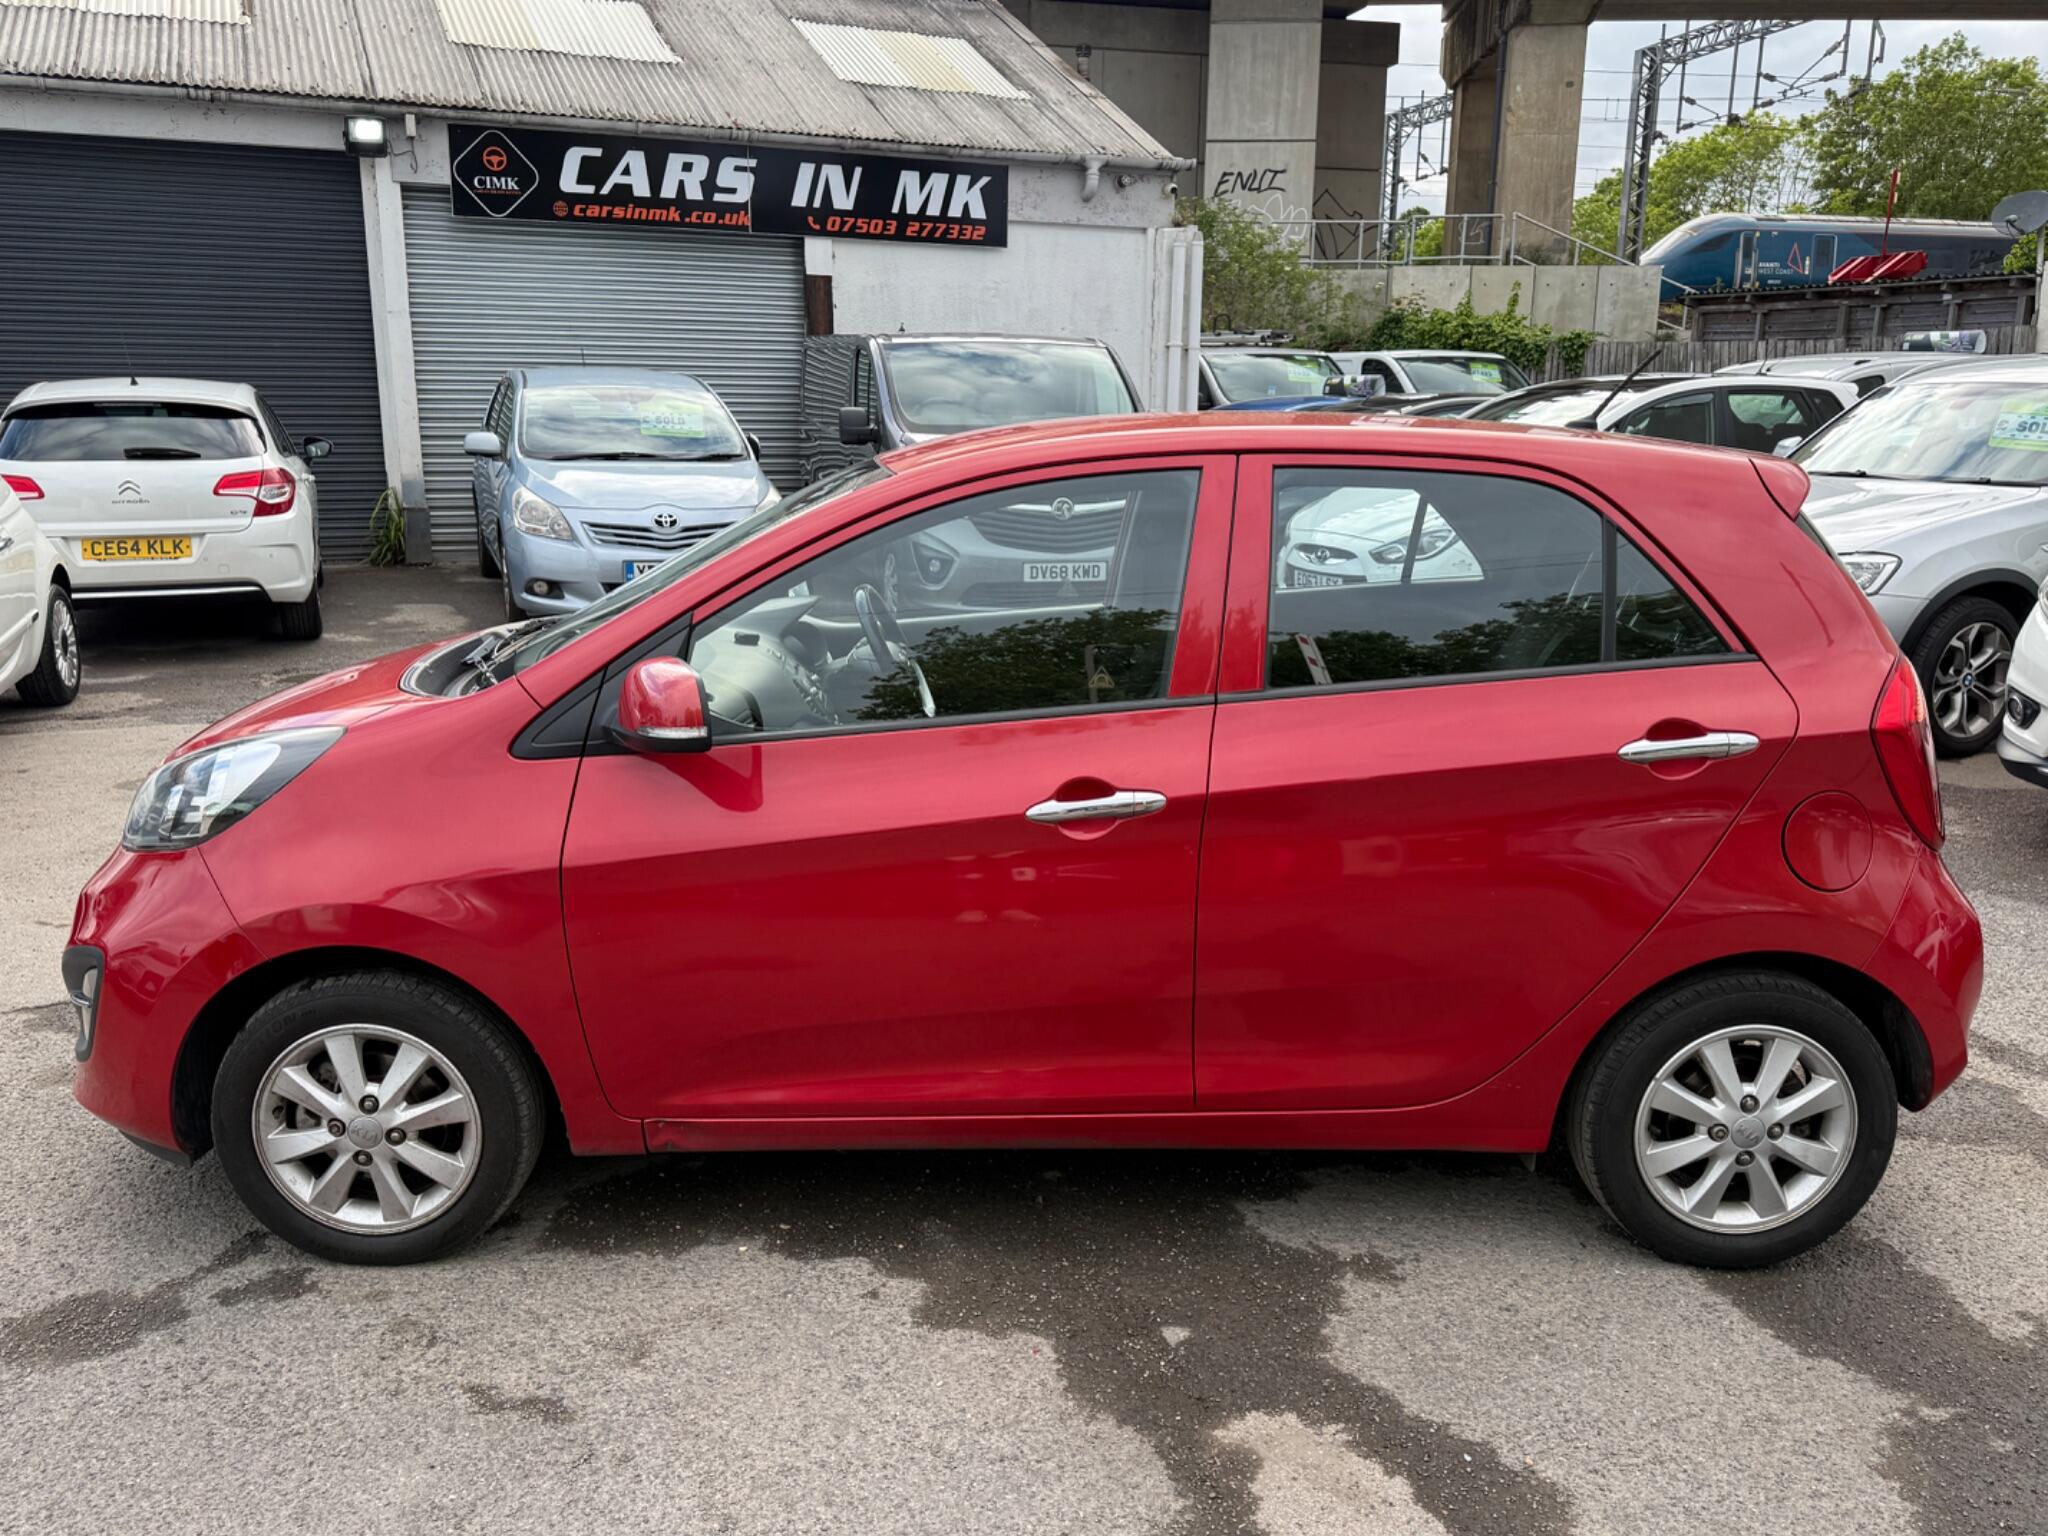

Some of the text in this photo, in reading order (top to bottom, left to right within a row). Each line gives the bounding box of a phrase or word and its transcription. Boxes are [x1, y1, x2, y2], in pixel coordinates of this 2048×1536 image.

[473, 175, 520, 190] CIMK
[559, 146, 991, 220] CARS IN MK
[573, 203, 750, 227] carsinmk.co.uk
[826, 216, 986, 240] 07503 277332
[2016, 420, 2048, 433] SOL
[90, 538, 184, 556] CE64 KLK
[1029, 564, 1101, 579] DV68 KWD
